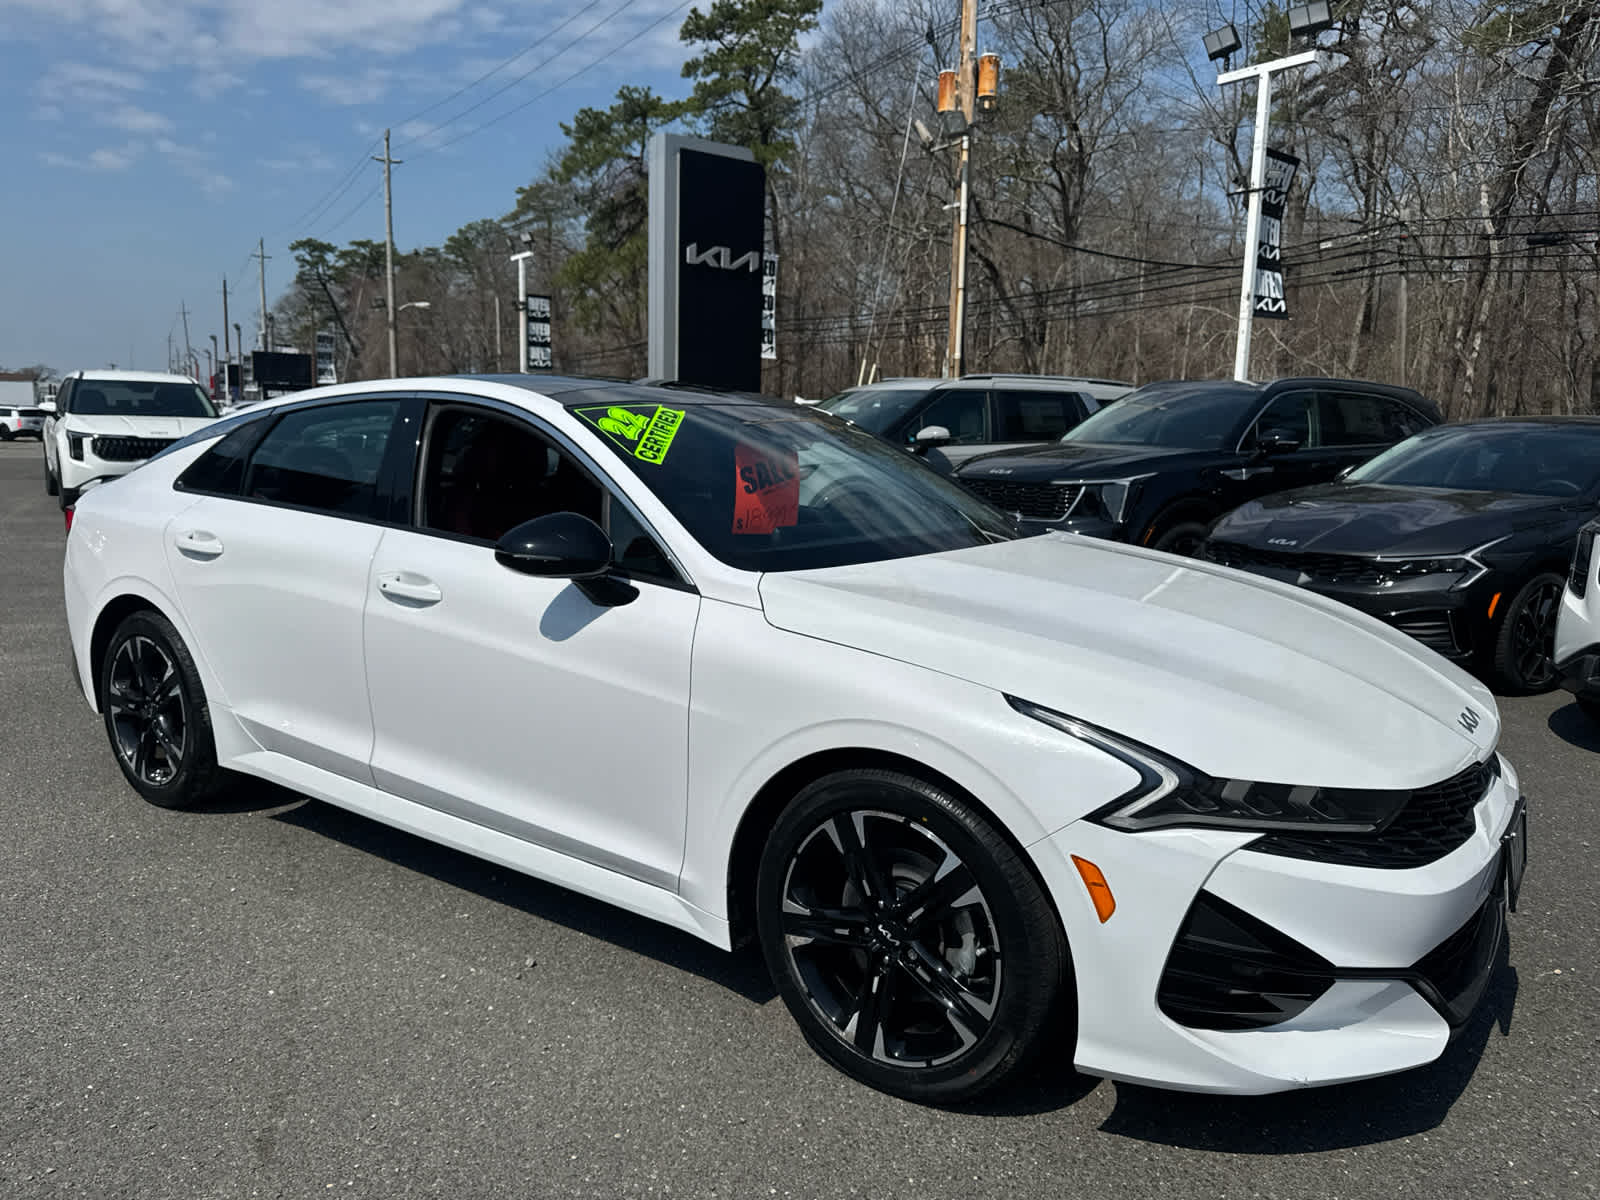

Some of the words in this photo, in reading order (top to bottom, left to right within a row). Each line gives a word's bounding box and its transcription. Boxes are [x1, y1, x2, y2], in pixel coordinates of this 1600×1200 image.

[686, 242, 760, 273] KIA
[598, 407, 650, 441] 22
[638, 410, 679, 461] CERTIFIED
[1268, 537, 1298, 547] KIA
[1456, 706, 1482, 735] KIA
